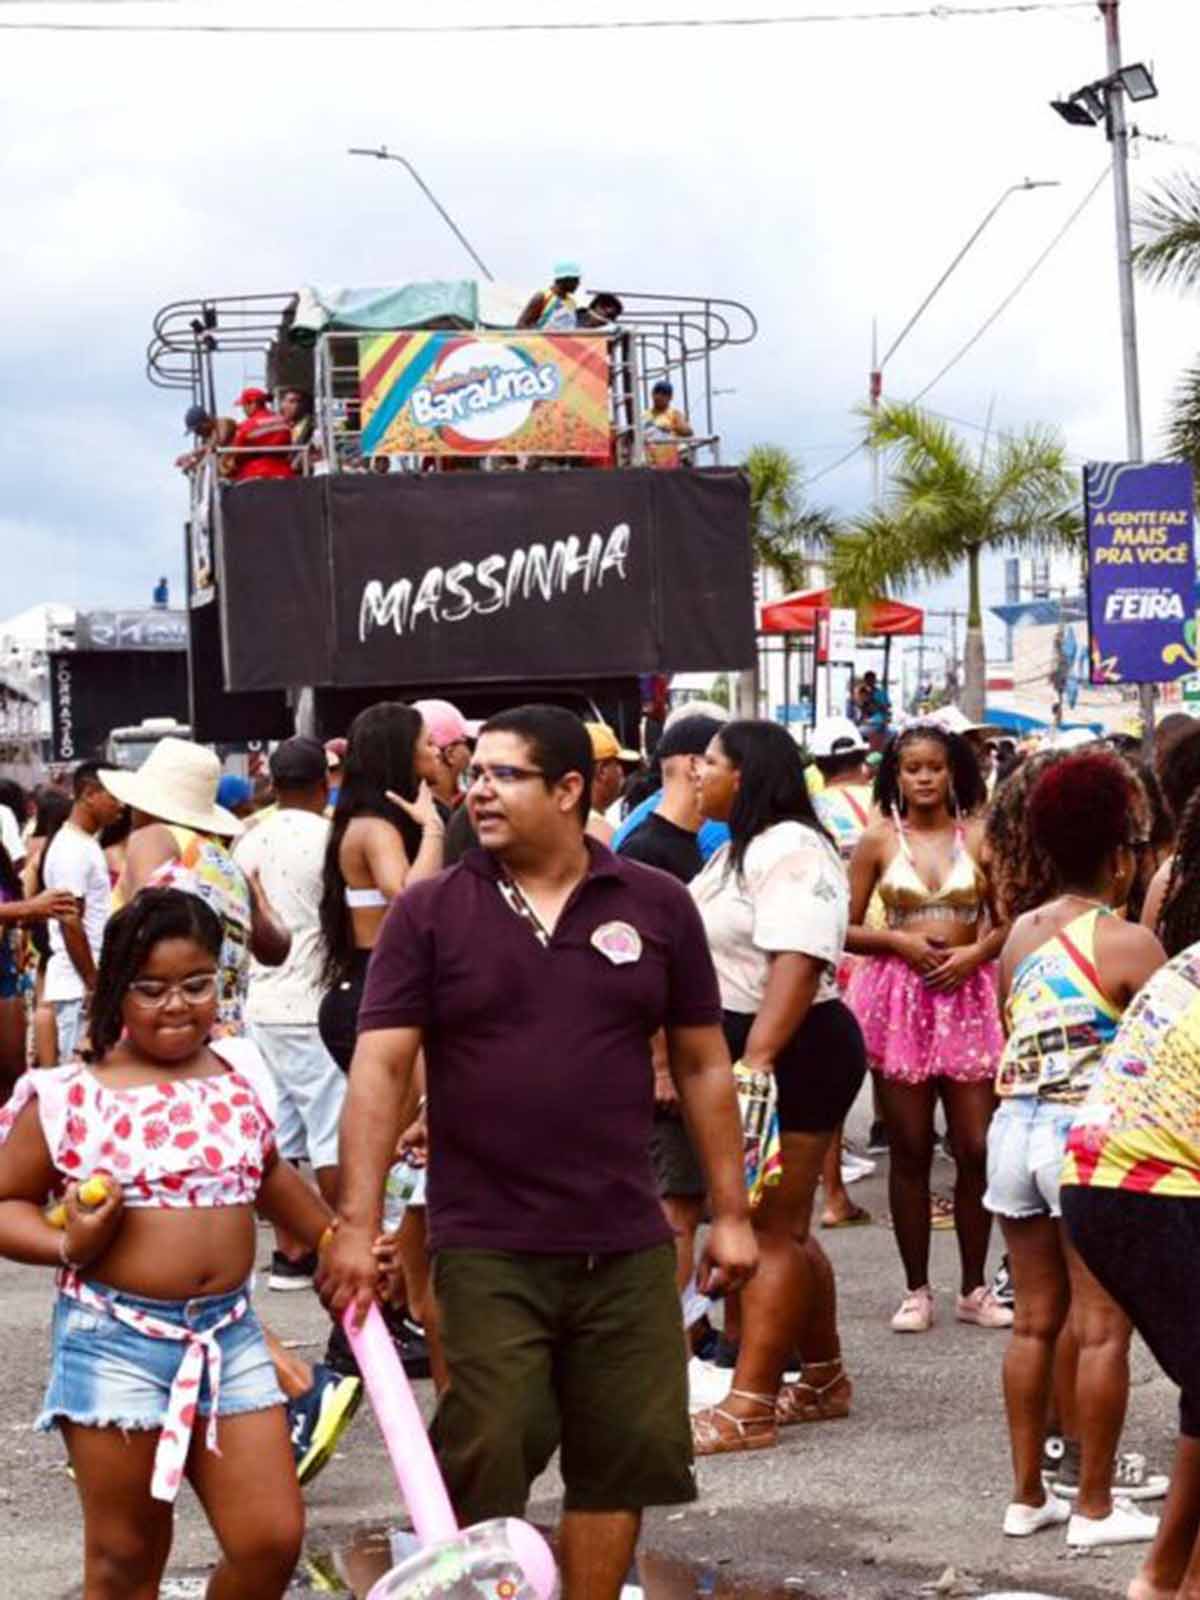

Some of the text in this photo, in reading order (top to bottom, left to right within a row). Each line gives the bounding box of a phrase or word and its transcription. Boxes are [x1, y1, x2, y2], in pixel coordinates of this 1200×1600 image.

[1113, 527, 1167, 545] MAIS
[1094, 547, 1133, 564] PRA
[359, 523, 630, 642] MASSINHA
[1105, 593, 1184, 621] FEIRA
